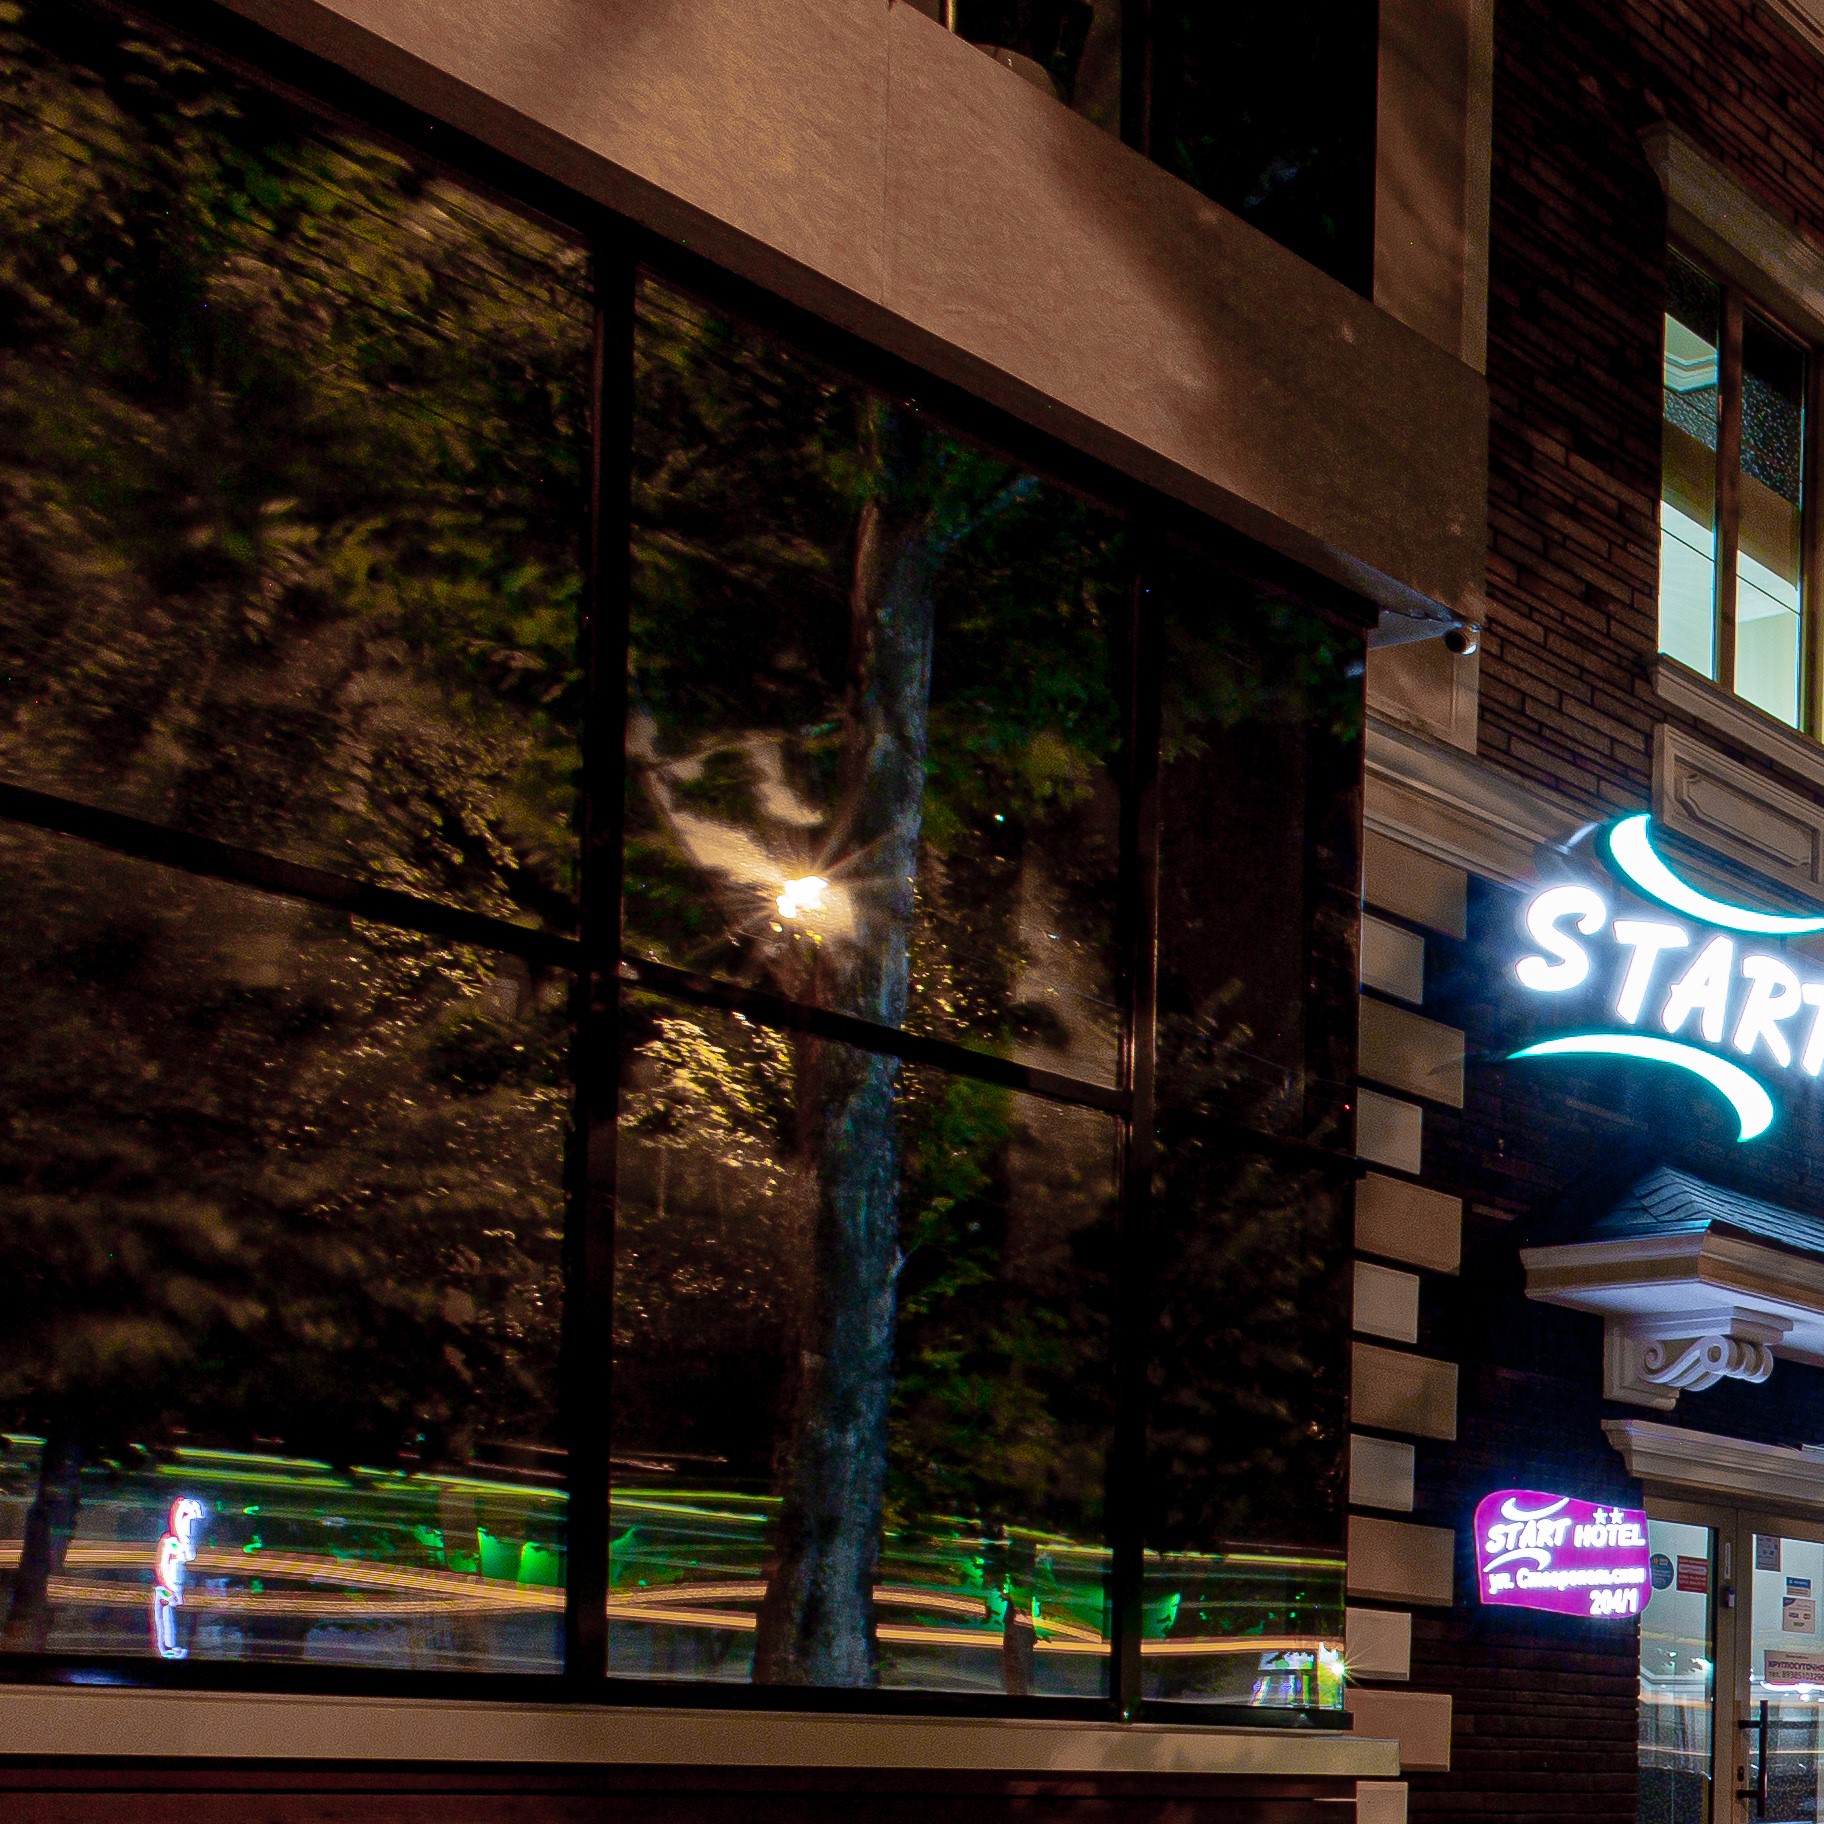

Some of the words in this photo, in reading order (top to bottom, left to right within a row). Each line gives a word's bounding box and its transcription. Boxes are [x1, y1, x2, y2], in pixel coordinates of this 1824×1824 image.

[1485, 1517, 1572, 1554] START
[1573, 1523, 1646, 1548] HOTEL
[1589, 1587, 1639, 1615] 204/1
